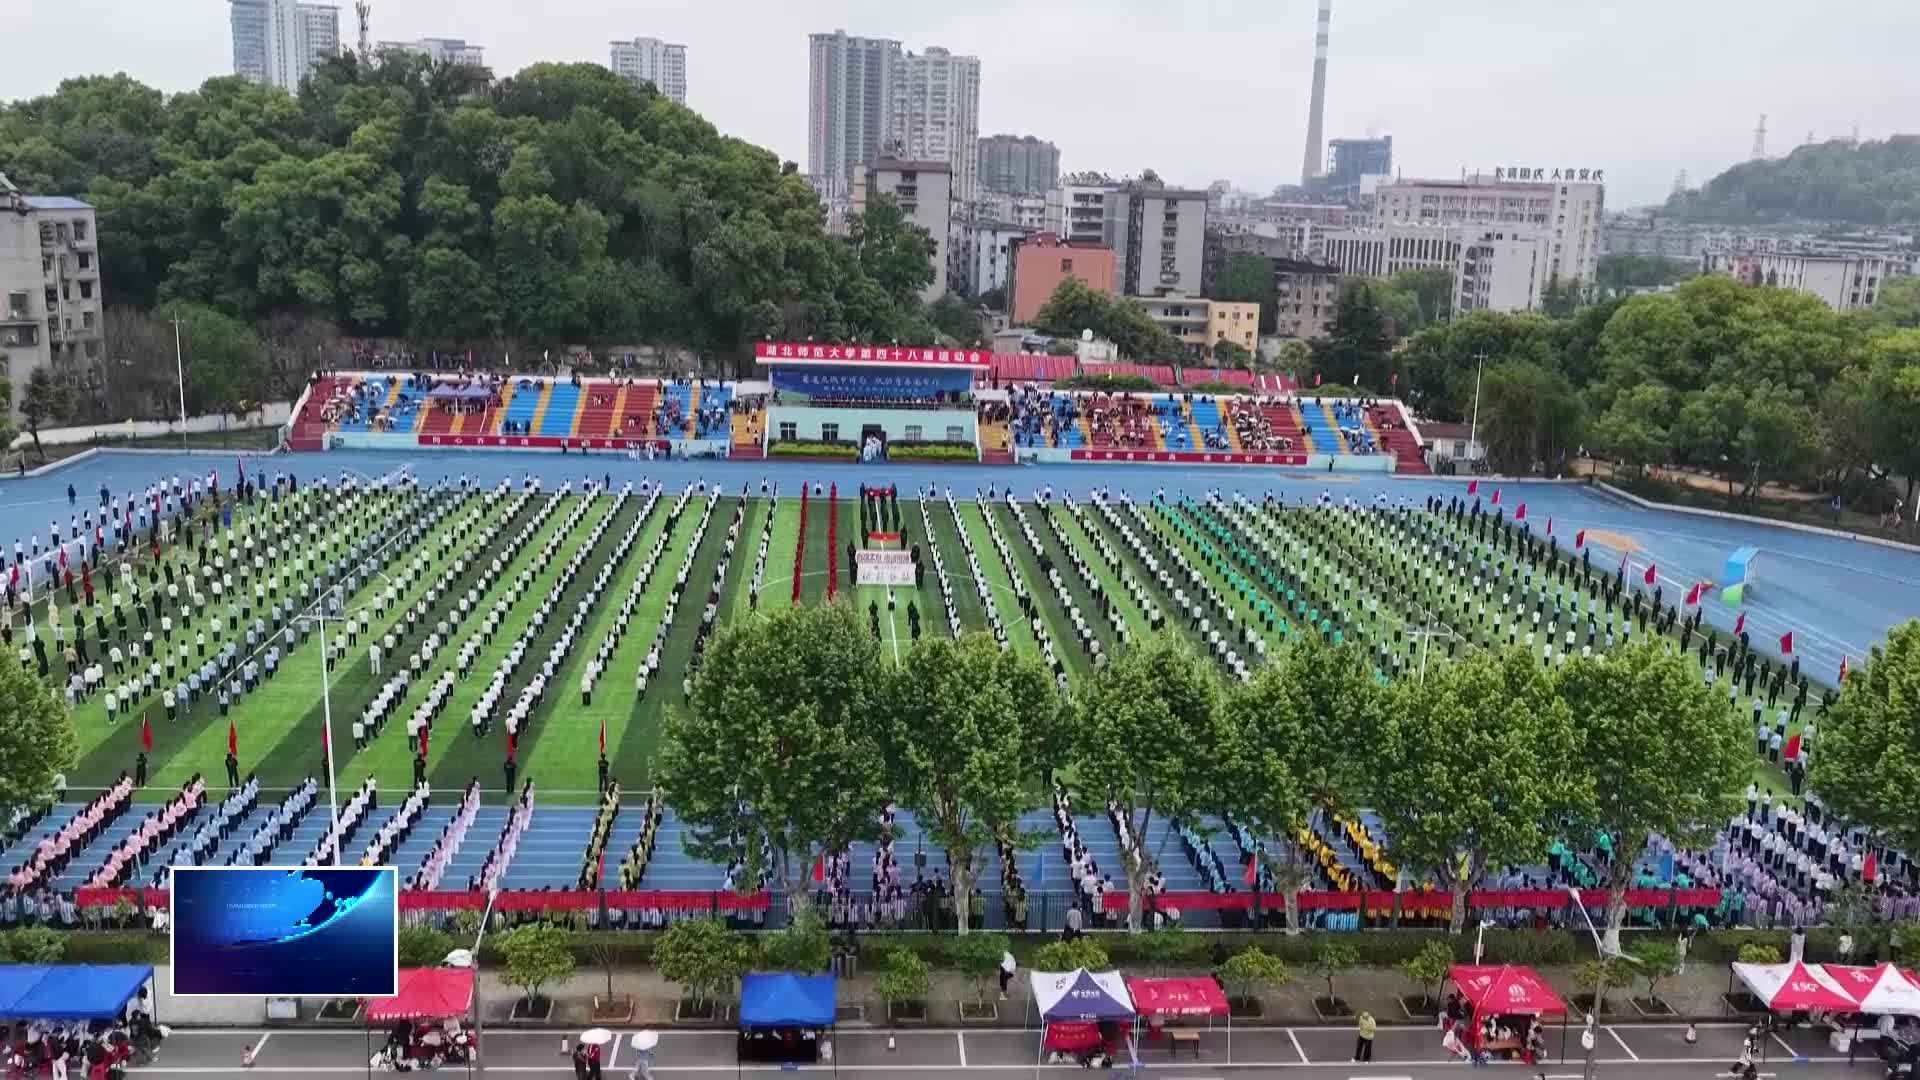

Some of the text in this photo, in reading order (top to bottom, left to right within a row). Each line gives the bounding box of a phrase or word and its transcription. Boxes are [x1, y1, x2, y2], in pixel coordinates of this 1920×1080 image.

[766, 344, 980, 363] 湖北师范大学第四十八届运动会
